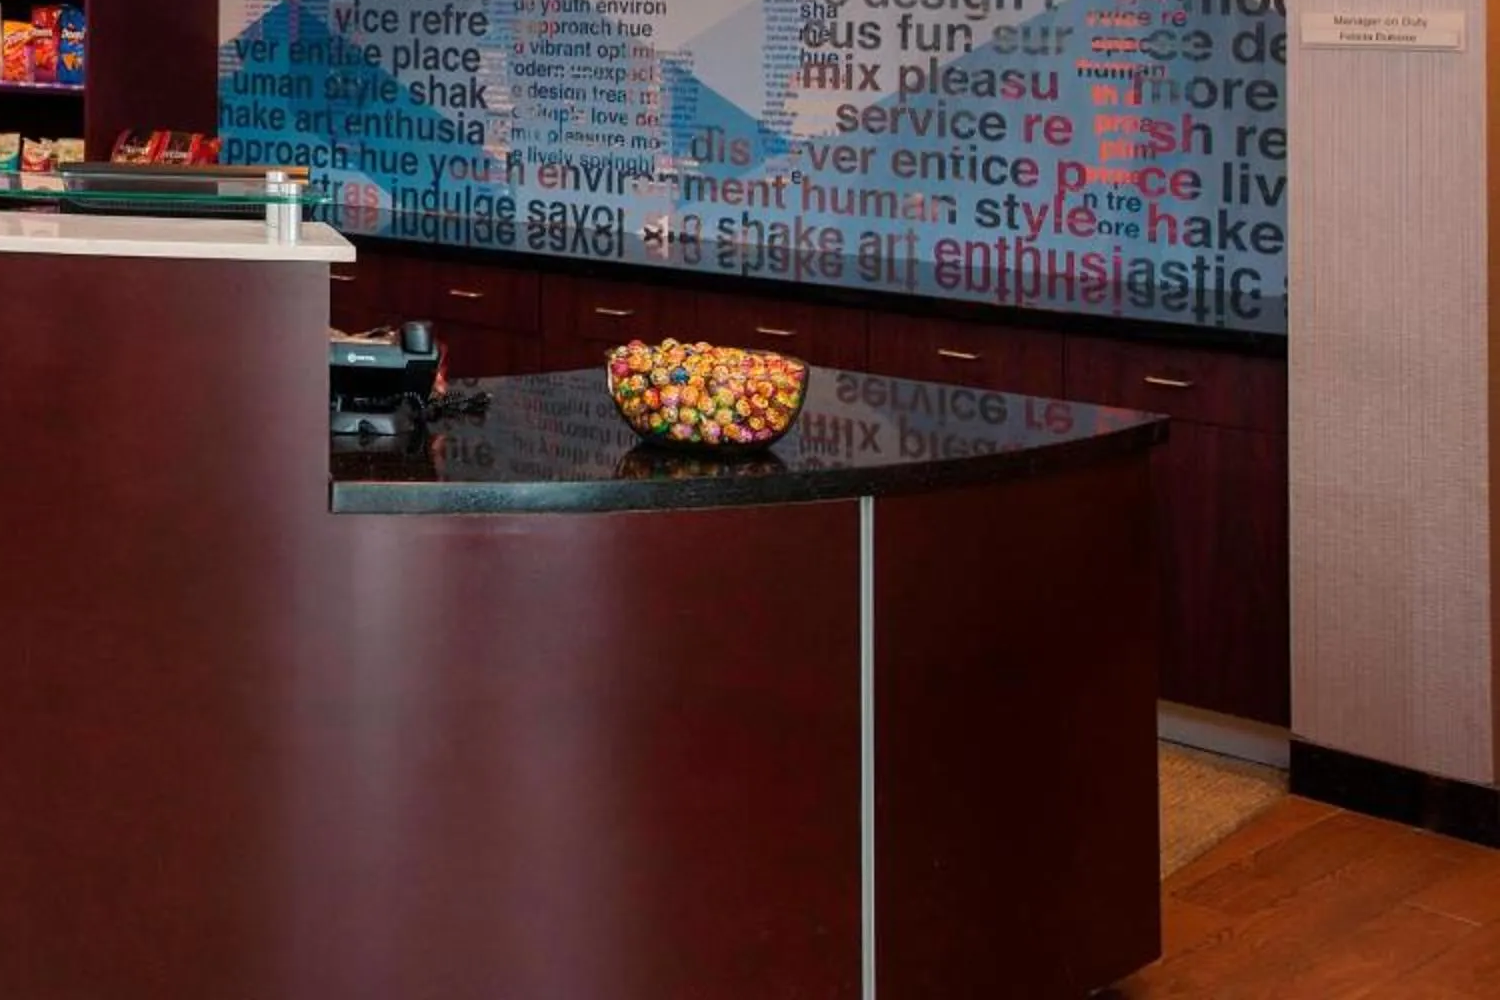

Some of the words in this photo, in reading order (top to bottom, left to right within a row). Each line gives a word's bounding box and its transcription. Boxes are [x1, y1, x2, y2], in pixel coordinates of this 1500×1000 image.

[334, 3, 399, 34] vice
[409, 4, 490, 37] refre
[617, 19, 654, 38] hue
[801, 1, 838, 19] sha
[1161, 8, 1189, 27] re
[529, 38, 592, 58] vibrant
[897, 13, 974, 53] fun
[991, 22, 1075, 55] sur
[235, 37, 280, 63] ver
[392, 39, 482, 77] place
[232, 71, 313, 98] uman
[324, 71, 399, 107] style
[408, 75, 489, 110] shak
[527, 81, 588, 100] design
[802, 54, 882, 91] mix
[899, 57, 1059, 105] pleasu
[1133, 71, 1279, 112] more
[294, 105, 334, 135] art
[344, 111, 486, 145] enthusia
[590, 107, 630, 126] love
[835, 98, 1007, 142] service
[1021, 113, 1074, 147] re
[227, 135, 348, 169] pproach
[359, 141, 419, 176] hue
[1149, 112, 1214, 156] sh
[1236, 121, 1287, 161] re
[527, 146, 574, 167] lively
[691, 126, 751, 167] dis
[804, 140, 877, 174] ver
[891, 146, 1040, 189] entice
[1057, 158, 1088, 199] p
[1136, 165, 1202, 201] ce
[1221, 161, 1287, 208] liv
[791, 170, 802, 185] e
[801, 174, 957, 225] human
[974, 190, 1098, 241] style
[1147, 202, 1285, 255] hake
[1106, 191, 1142, 213] tre
[1098, 219, 1141, 240] ore
[858, 227, 919, 262] art
[932, 236, 1262, 296] enthusiastic
